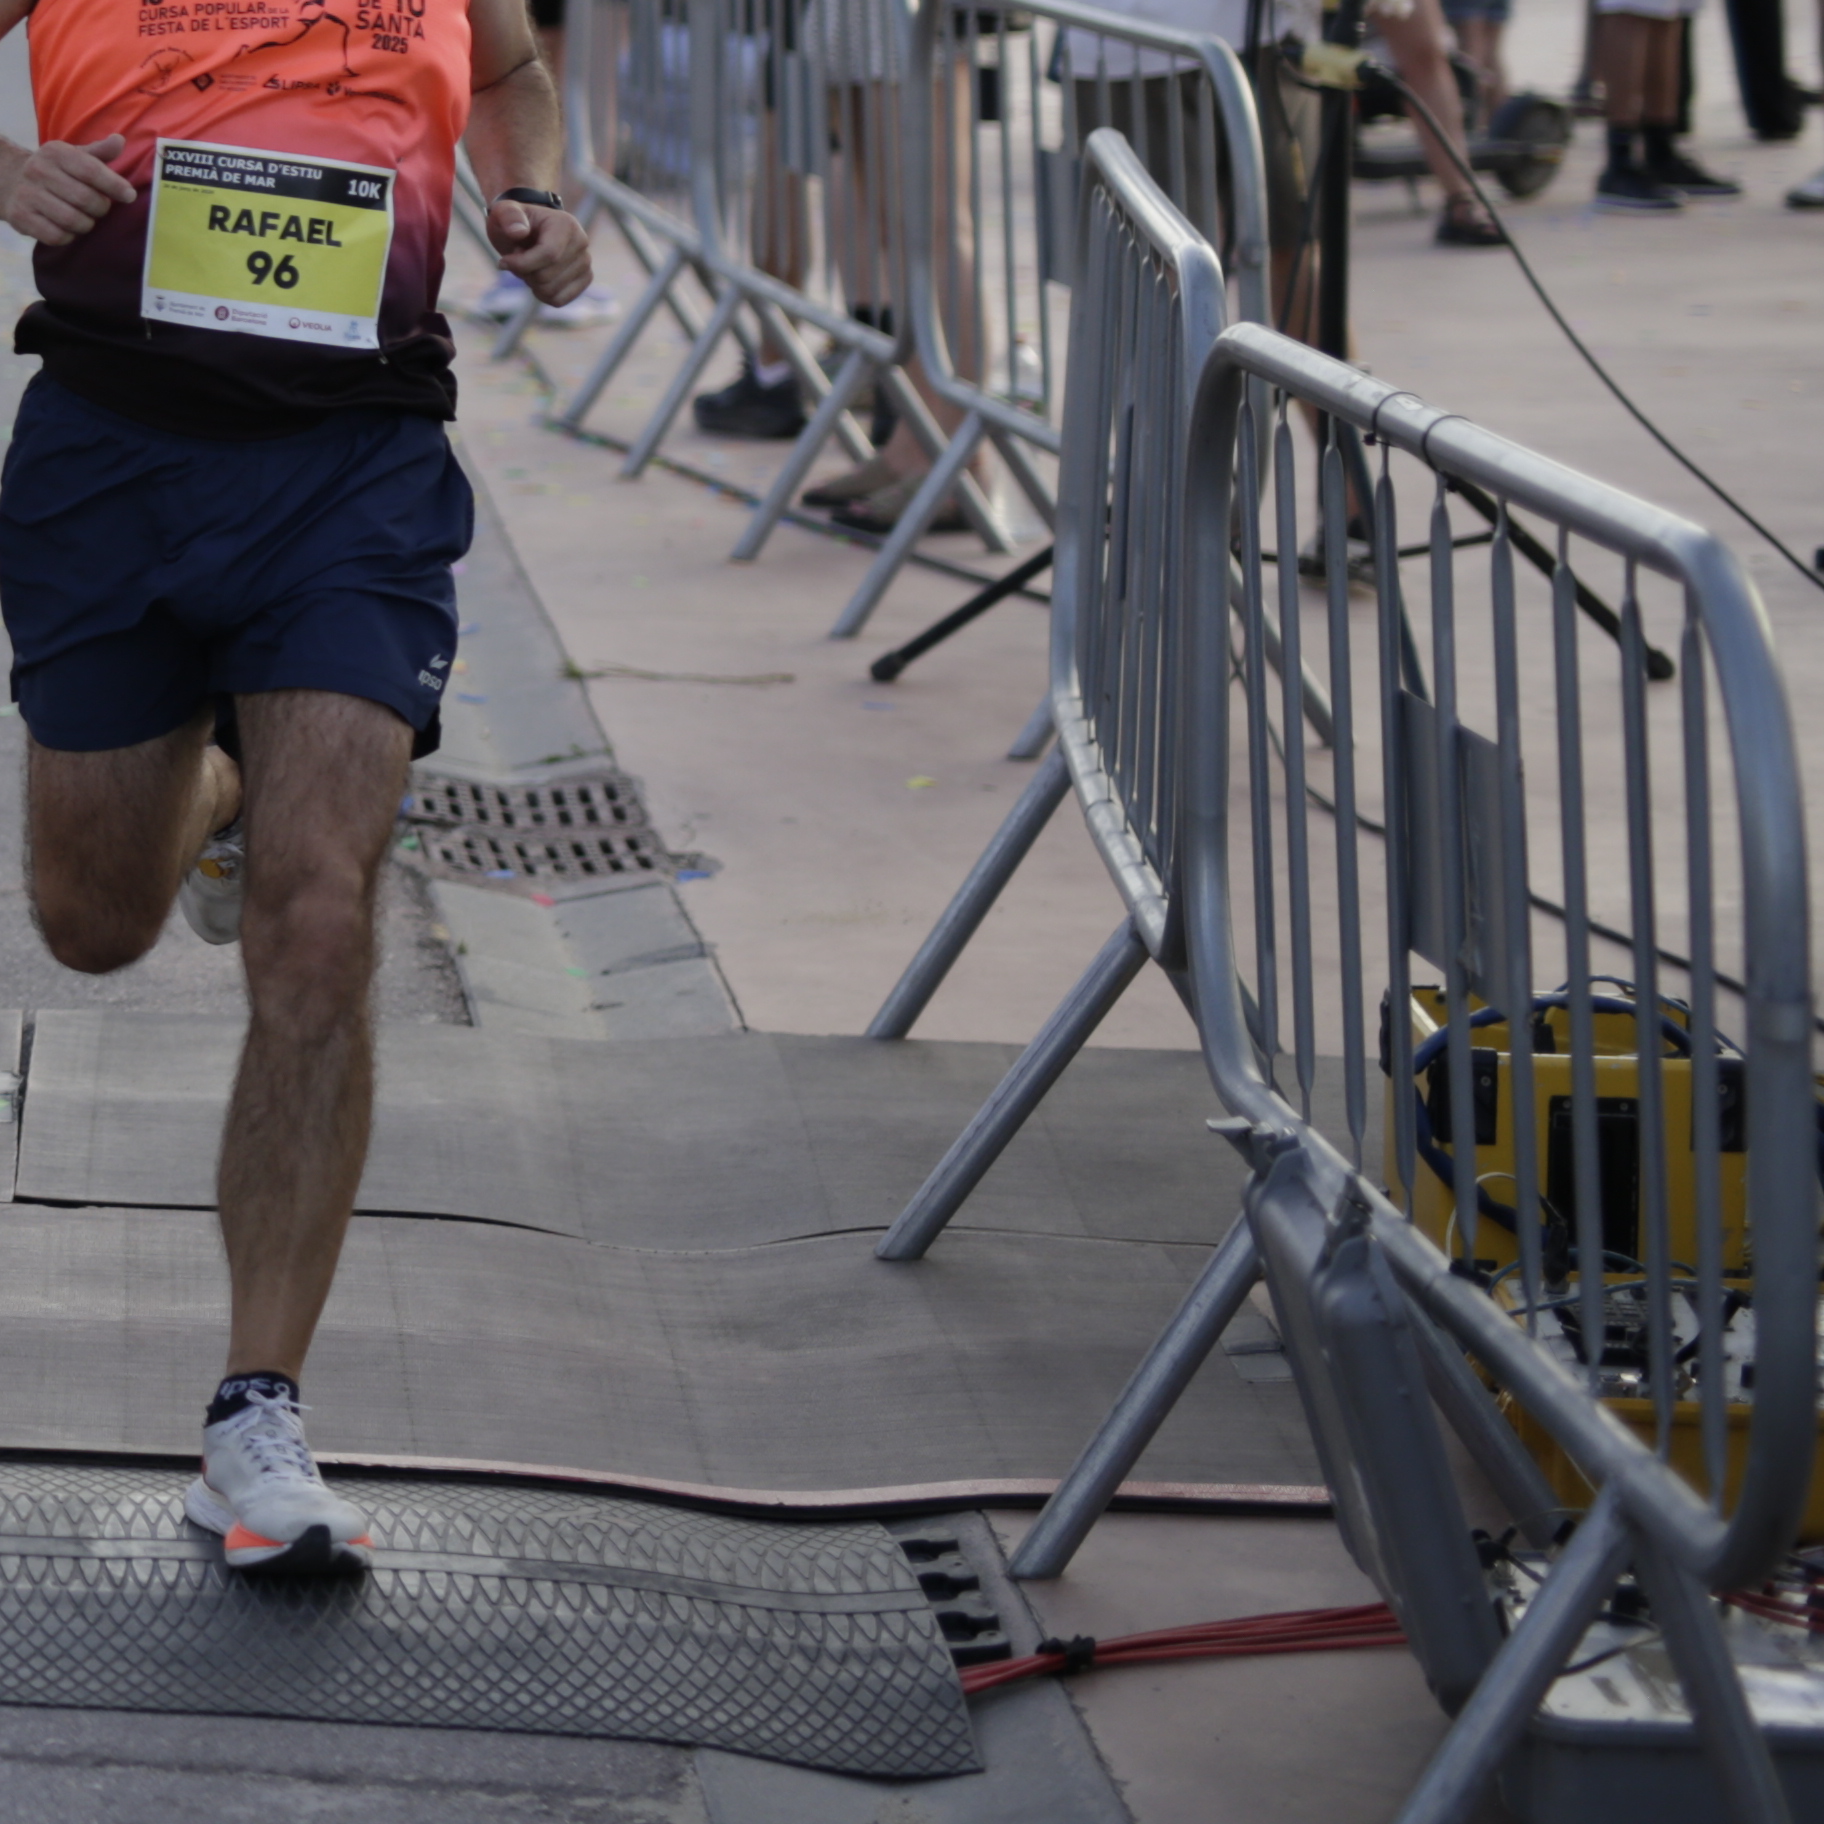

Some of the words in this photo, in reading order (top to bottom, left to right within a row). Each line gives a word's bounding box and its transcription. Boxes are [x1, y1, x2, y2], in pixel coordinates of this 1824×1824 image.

[139, 5, 189, 22] CURSA
[195, 1, 266, 16] POPULAR
[139, 21, 186, 37] FESTA
[191, 18, 210, 32] DE
[355, 10, 425, 42] SANTA
[371, 33, 409, 54] 2025
[165, 164, 219, 181] PREMIÀ
[222, 171, 241, 183] DE
[244, 175, 276, 188] MAR
[166, 150, 214, 165] XXVIII
[218, 156, 264, 172] CURSA
[268, 162, 323, 180] D'ESTIU
[347, 179, 382, 200] 10K
[208, 204, 342, 247] RAFAEL
[246, 250, 300, 289] 96
